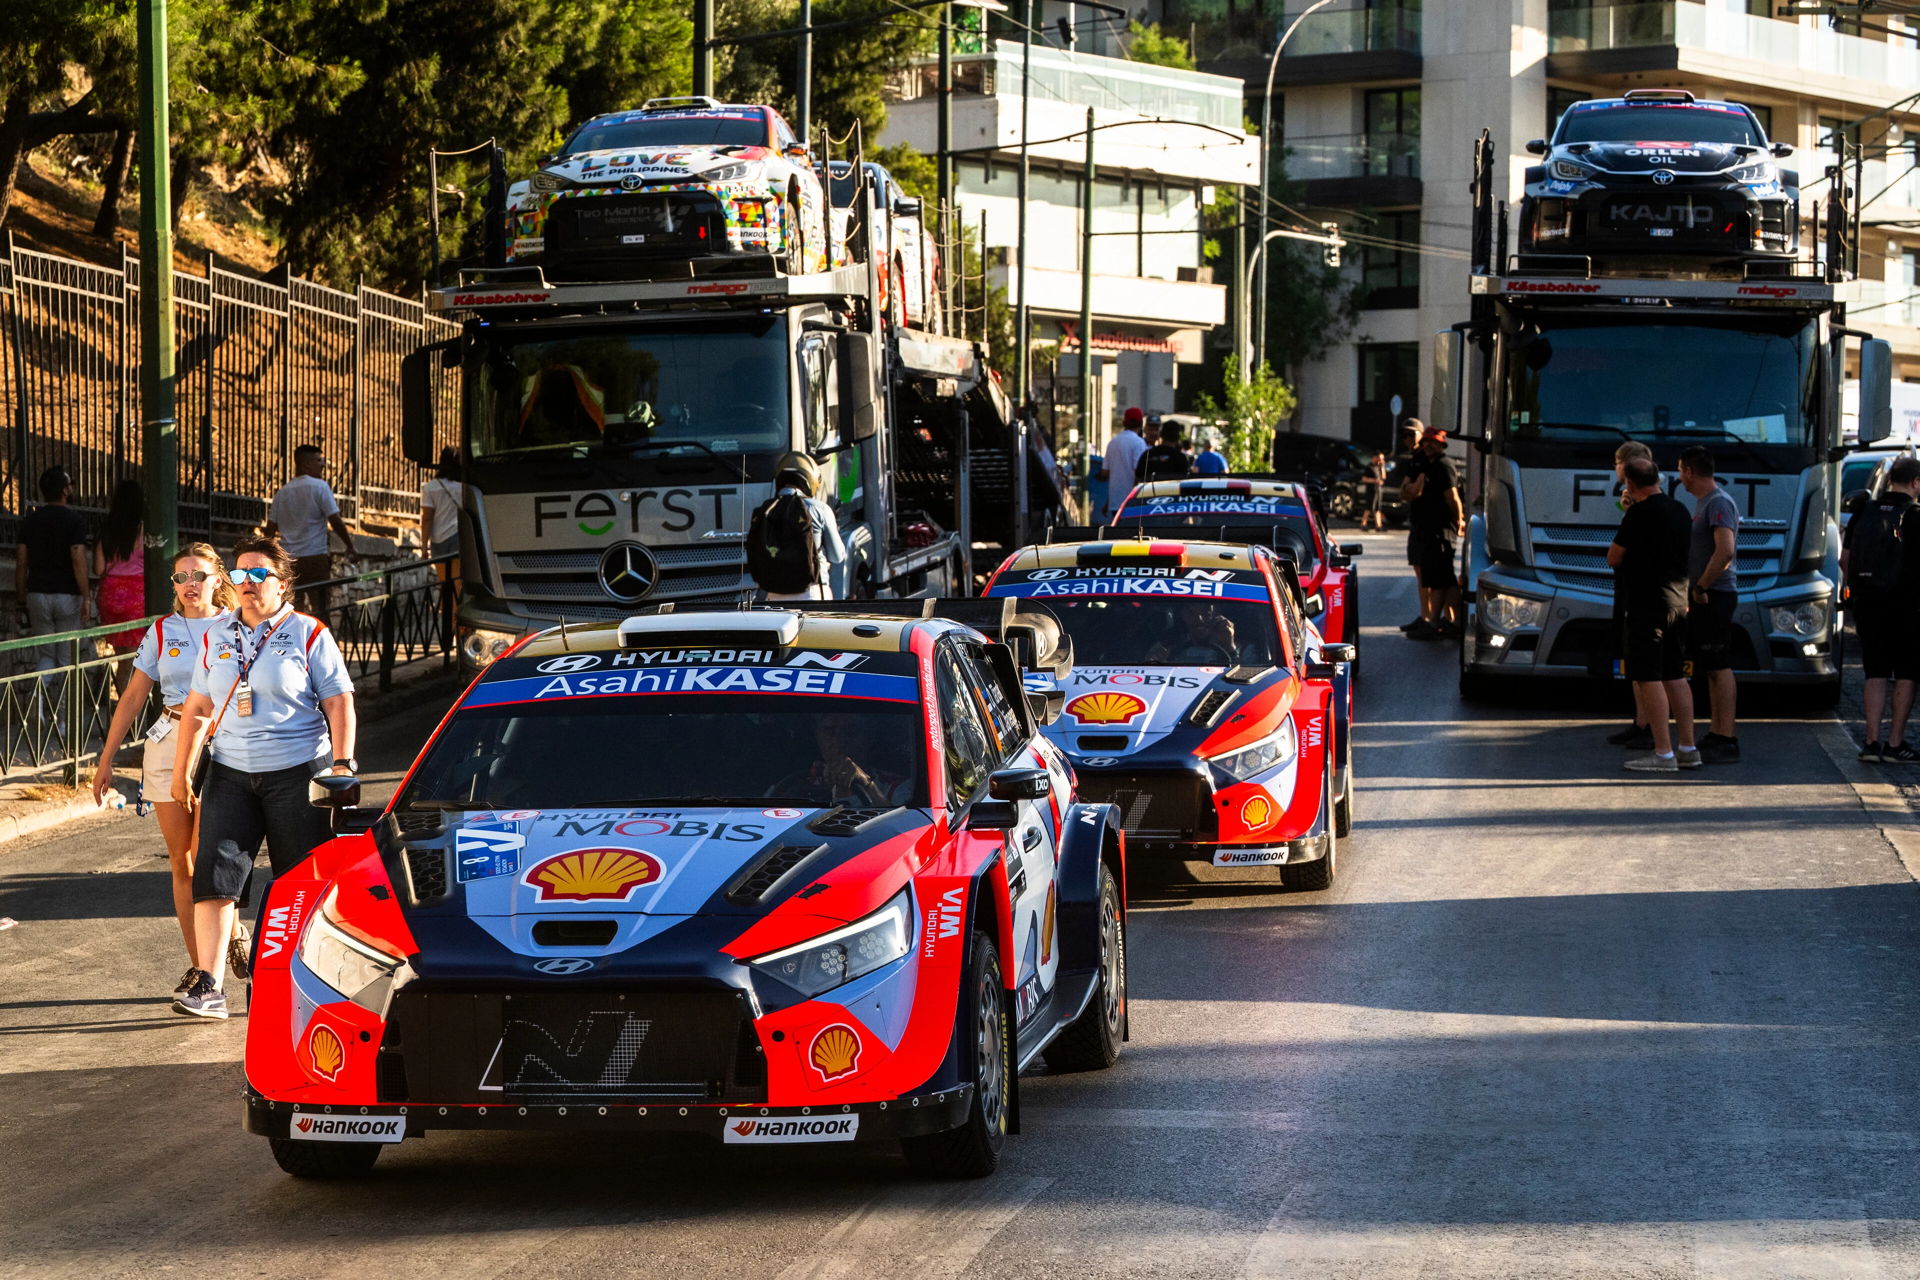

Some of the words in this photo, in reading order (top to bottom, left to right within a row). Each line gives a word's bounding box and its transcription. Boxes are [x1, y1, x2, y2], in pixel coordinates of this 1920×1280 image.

[1625, 148, 1699, 157] ORLEN
[1649, 156, 1677, 164] OIL
[581, 152, 692, 172] LOVE
[581, 170, 604, 180] THE
[608, 166, 690, 175] PHILIPPINES
[604, 205, 650, 217] Martin
[1610, 205, 1713, 223] KAJTO
[1075, 567, 1175, 577] HYUNDAI
[611, 650, 773, 666] HYUNDAI
[1073, 674, 1200, 689] MOBIS
[920, 657, 942, 752] motorsport.hyundai.com
[537, 812, 682, 822] HYUNDAI
[552, 819, 765, 842] MOBIS
[288, 890, 306, 934] HYUNDAI
[924, 909, 938, 958] HYUNDAI
